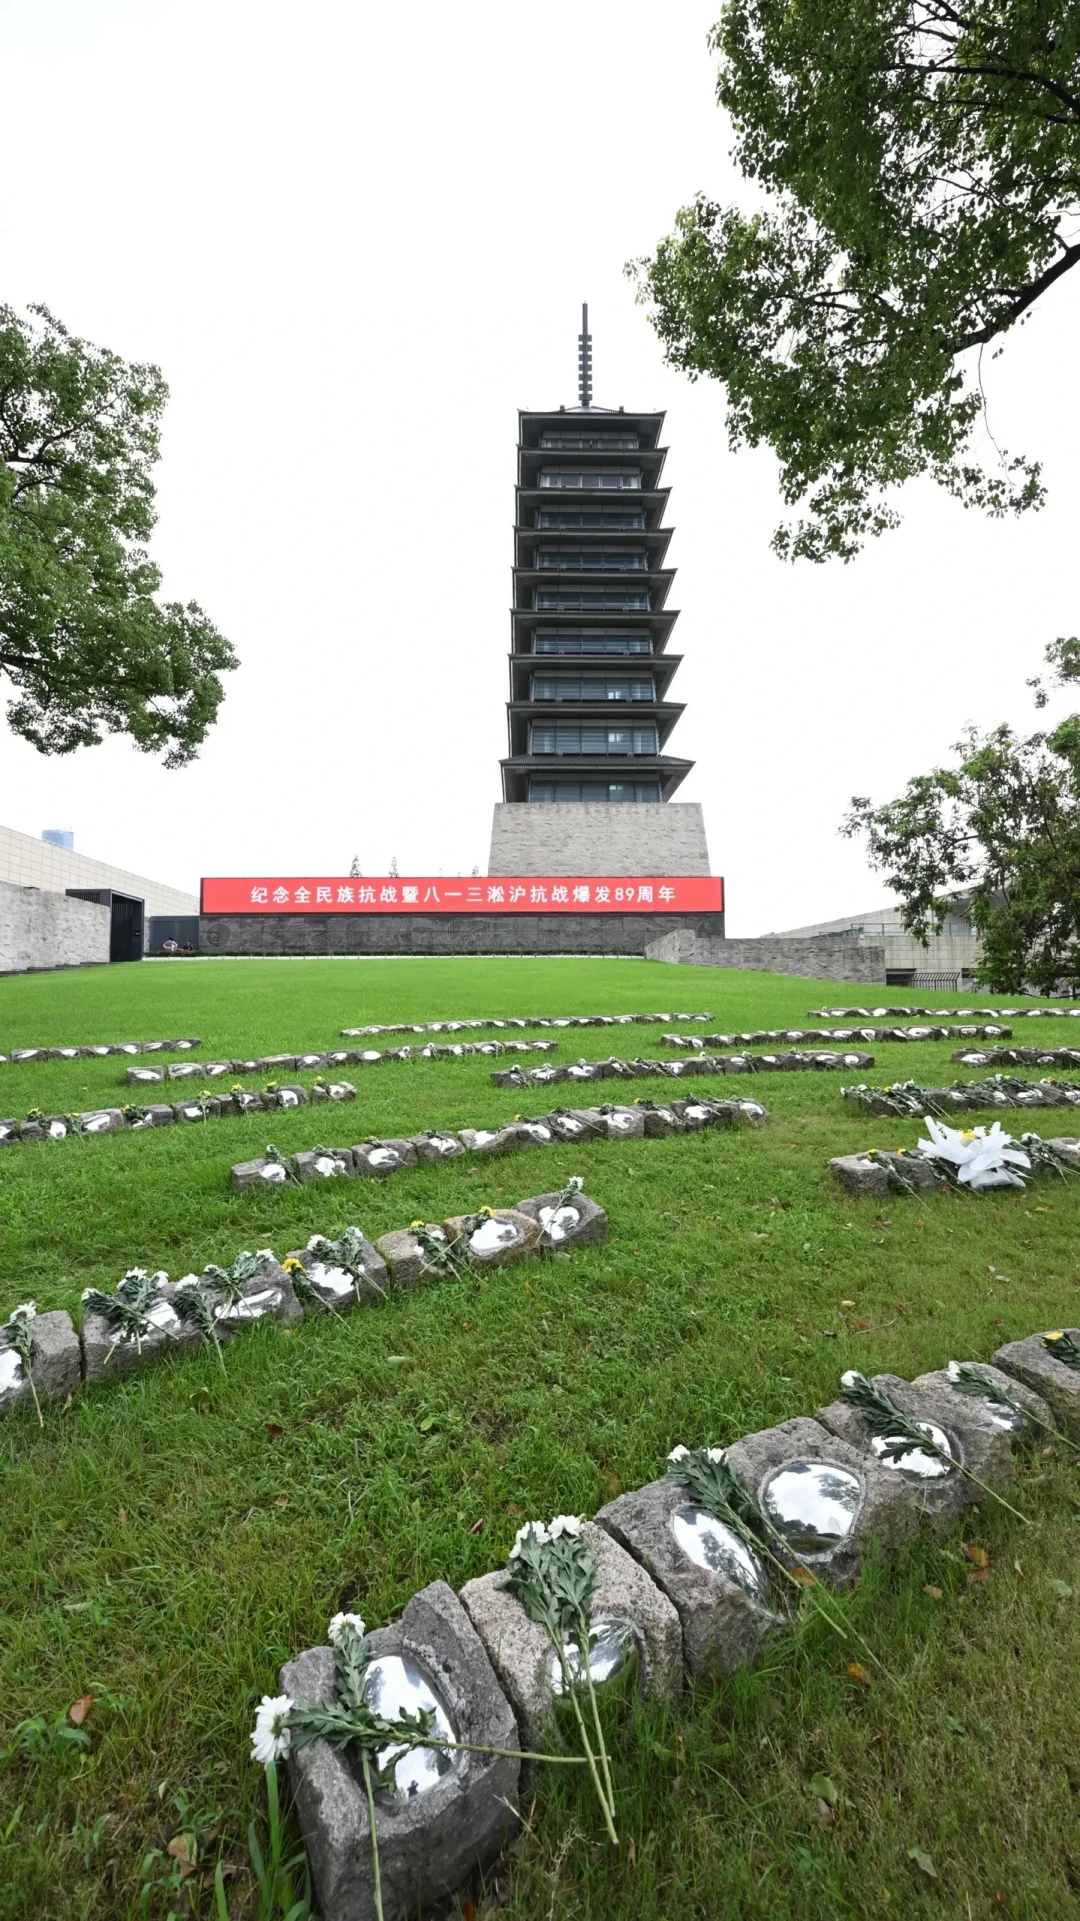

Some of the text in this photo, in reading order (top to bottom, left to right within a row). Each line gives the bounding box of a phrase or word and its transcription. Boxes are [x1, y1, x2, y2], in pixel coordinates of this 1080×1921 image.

[250, 886, 675, 903] 纪念全民族抗战暨八一三淞沪抗战爆发89周年
